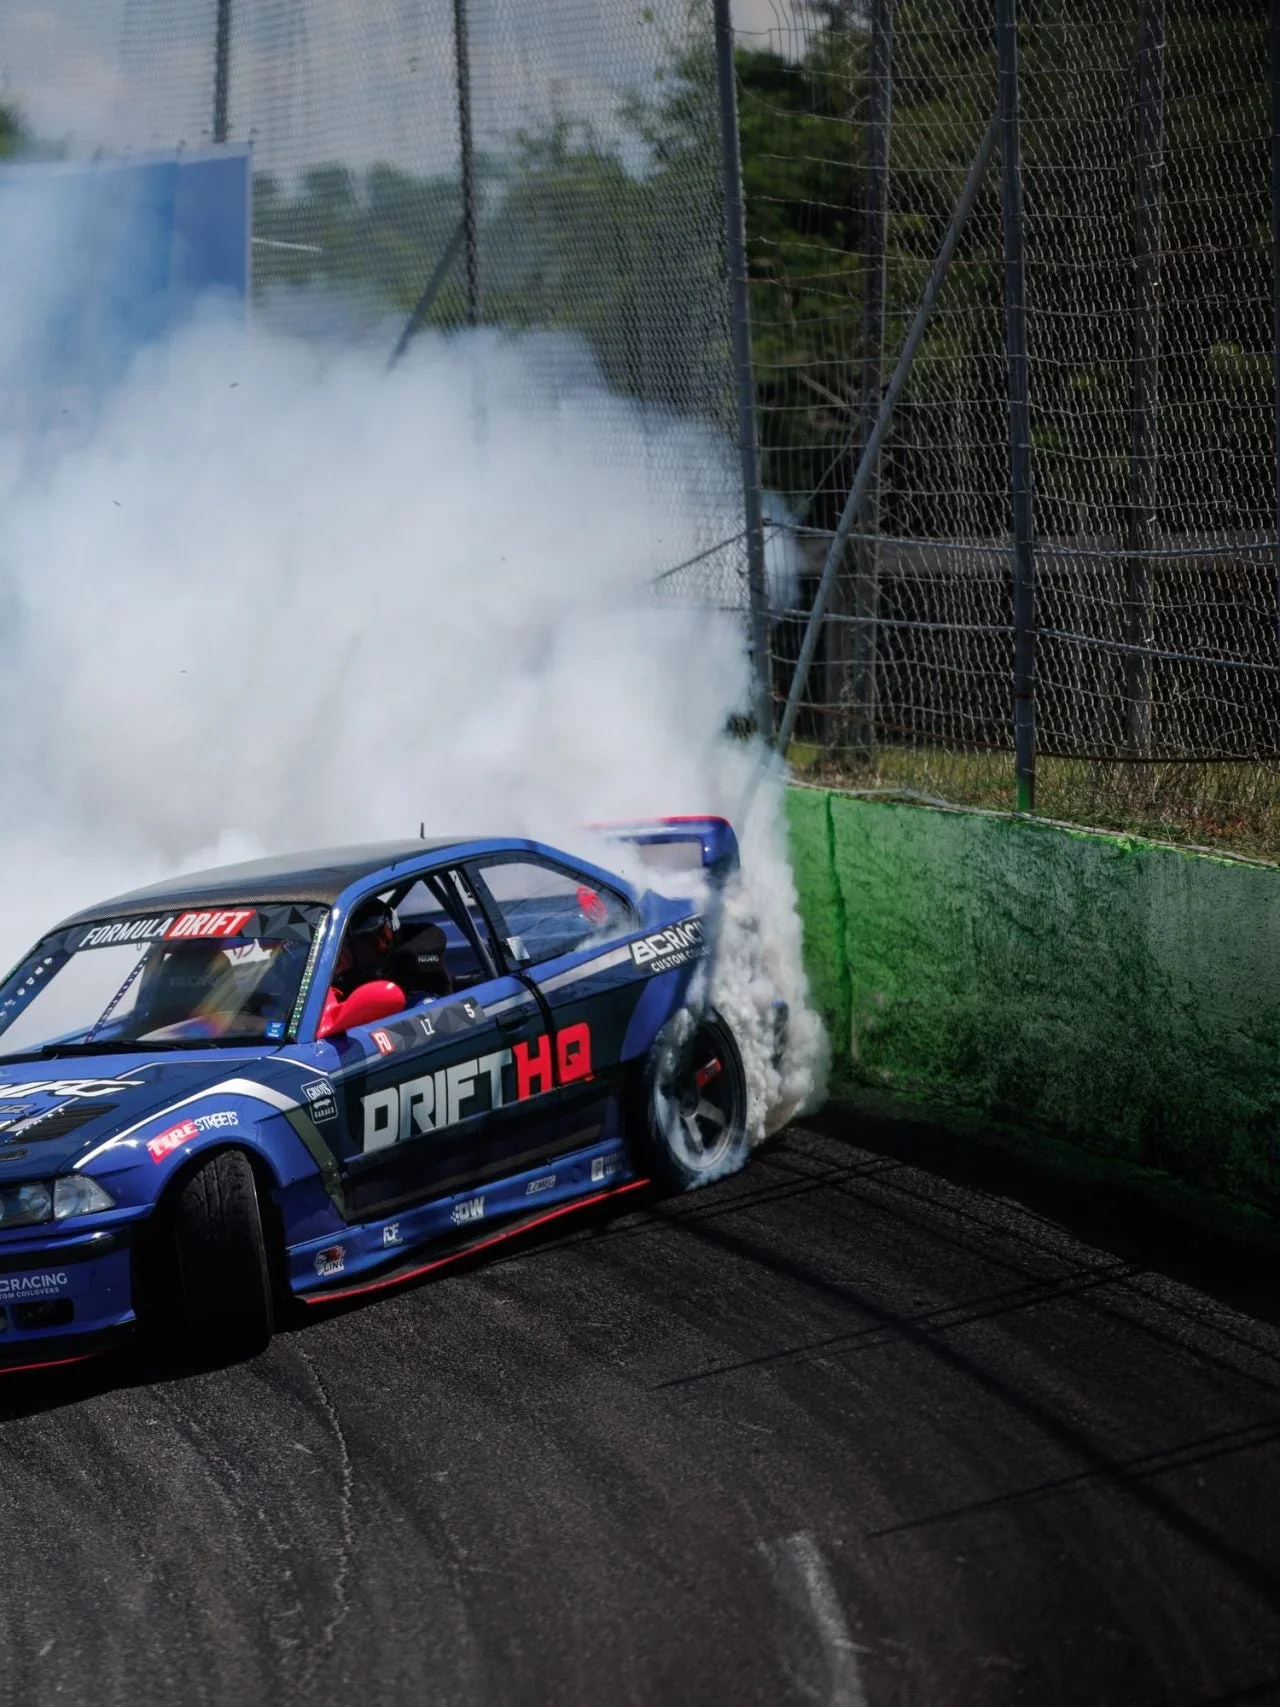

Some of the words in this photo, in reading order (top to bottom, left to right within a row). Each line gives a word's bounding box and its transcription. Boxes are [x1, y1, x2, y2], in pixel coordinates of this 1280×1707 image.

[78, 916, 175, 948] FORMULA
[170, 910, 251, 938] DRIFT
[651, 952, 687, 972] CUSTOM
[463, 1003, 475, 1019] 5
[194, 1111, 239, 1132] STREETS
[16, 1287, 60, 1298] COILOVERS
